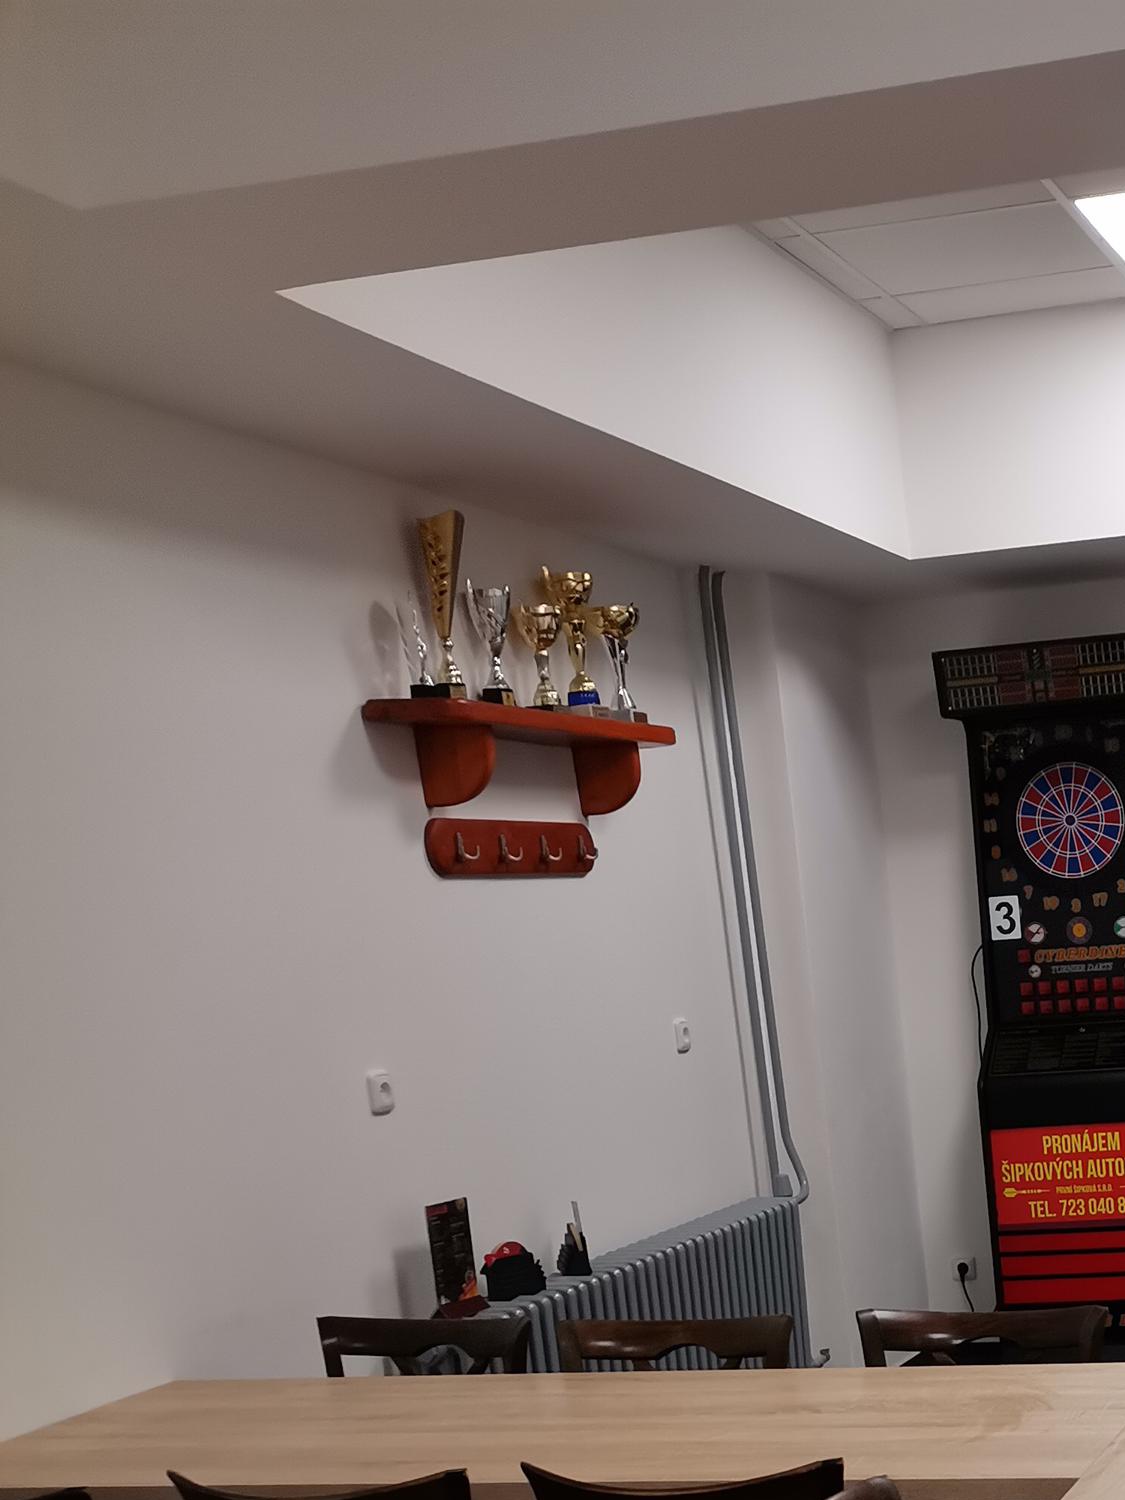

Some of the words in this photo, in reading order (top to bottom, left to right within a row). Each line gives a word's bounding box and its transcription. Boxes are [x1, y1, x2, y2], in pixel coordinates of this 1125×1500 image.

[995, 901, 1016, 935] 3
[1042, 1129, 1120, 1155] PRONÁJEM
[1001, 1157, 1083, 1183] ŠIPKOVÝCH
[1028, 1200, 1056, 1218] TEL.
[1059, 1199, 1085, 1216] 723
[1088, 1197, 1115, 1215] 040
